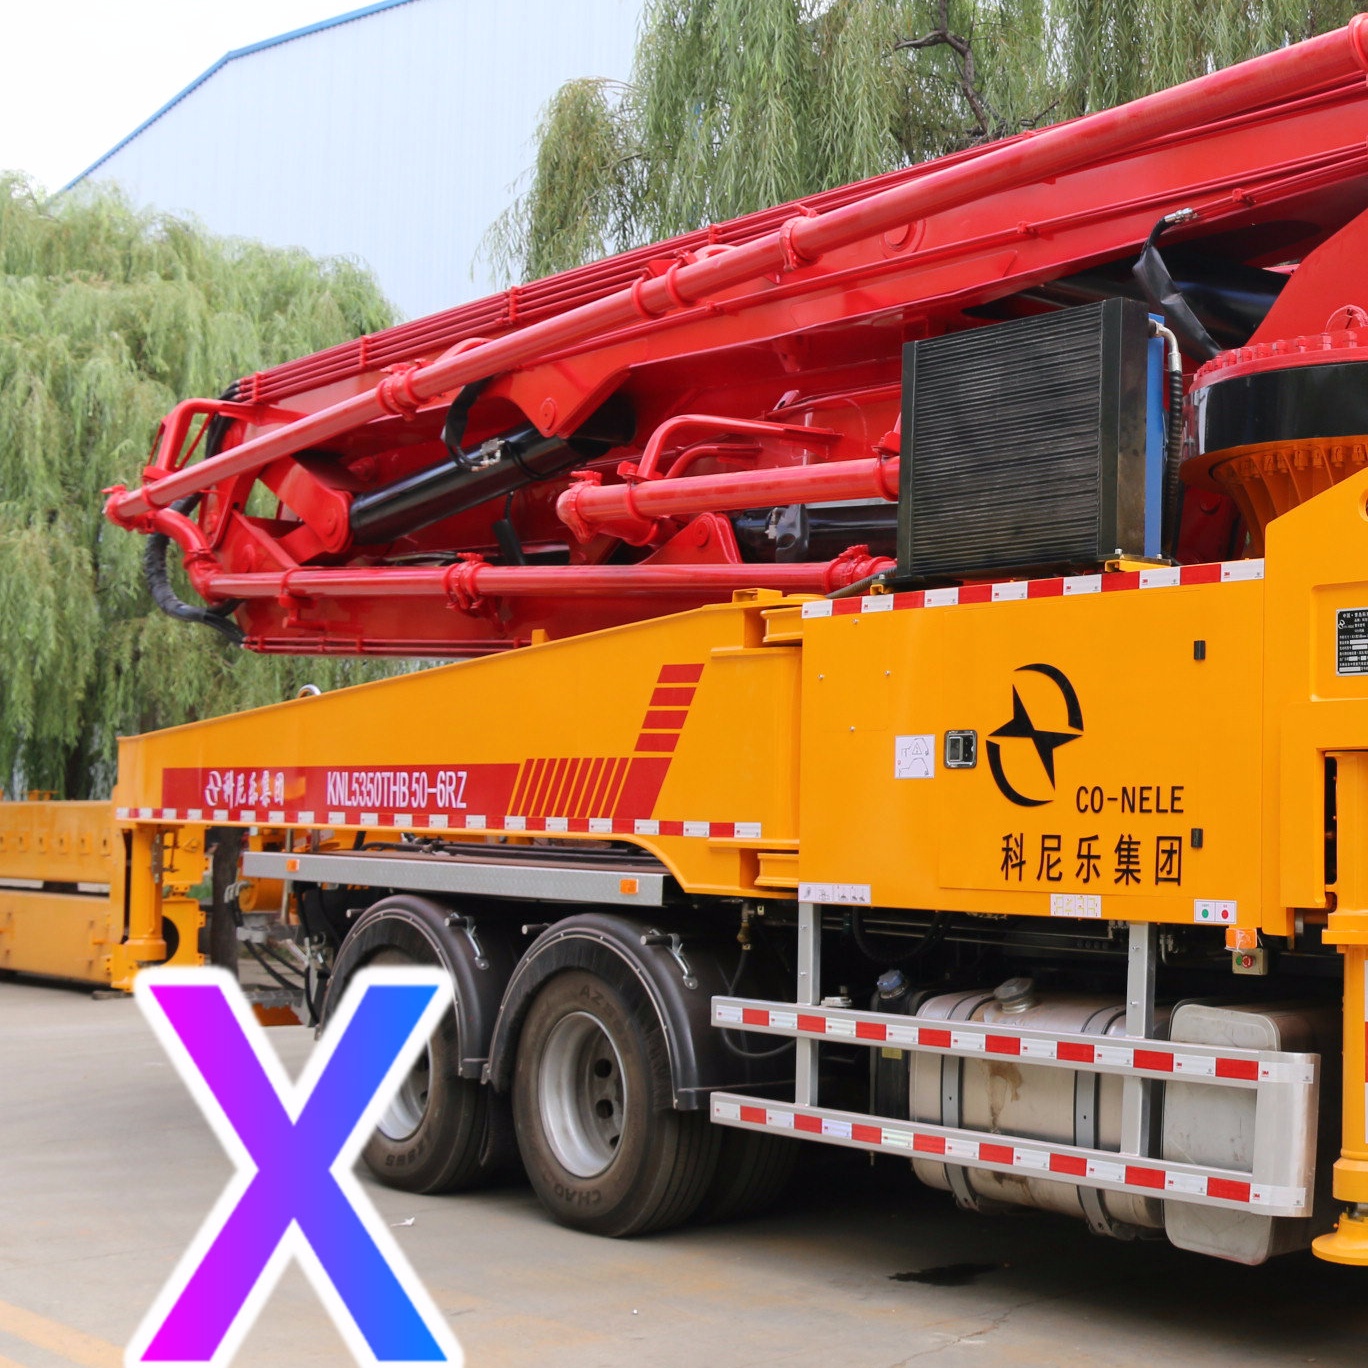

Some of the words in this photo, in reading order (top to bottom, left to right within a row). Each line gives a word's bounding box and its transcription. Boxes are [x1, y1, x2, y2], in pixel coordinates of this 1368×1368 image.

[223, 770, 285, 808] 科尼乐集团
[1076, 786, 1185, 813] CO-NELE
[1001, 833, 1182, 886] 科尼乐集团
